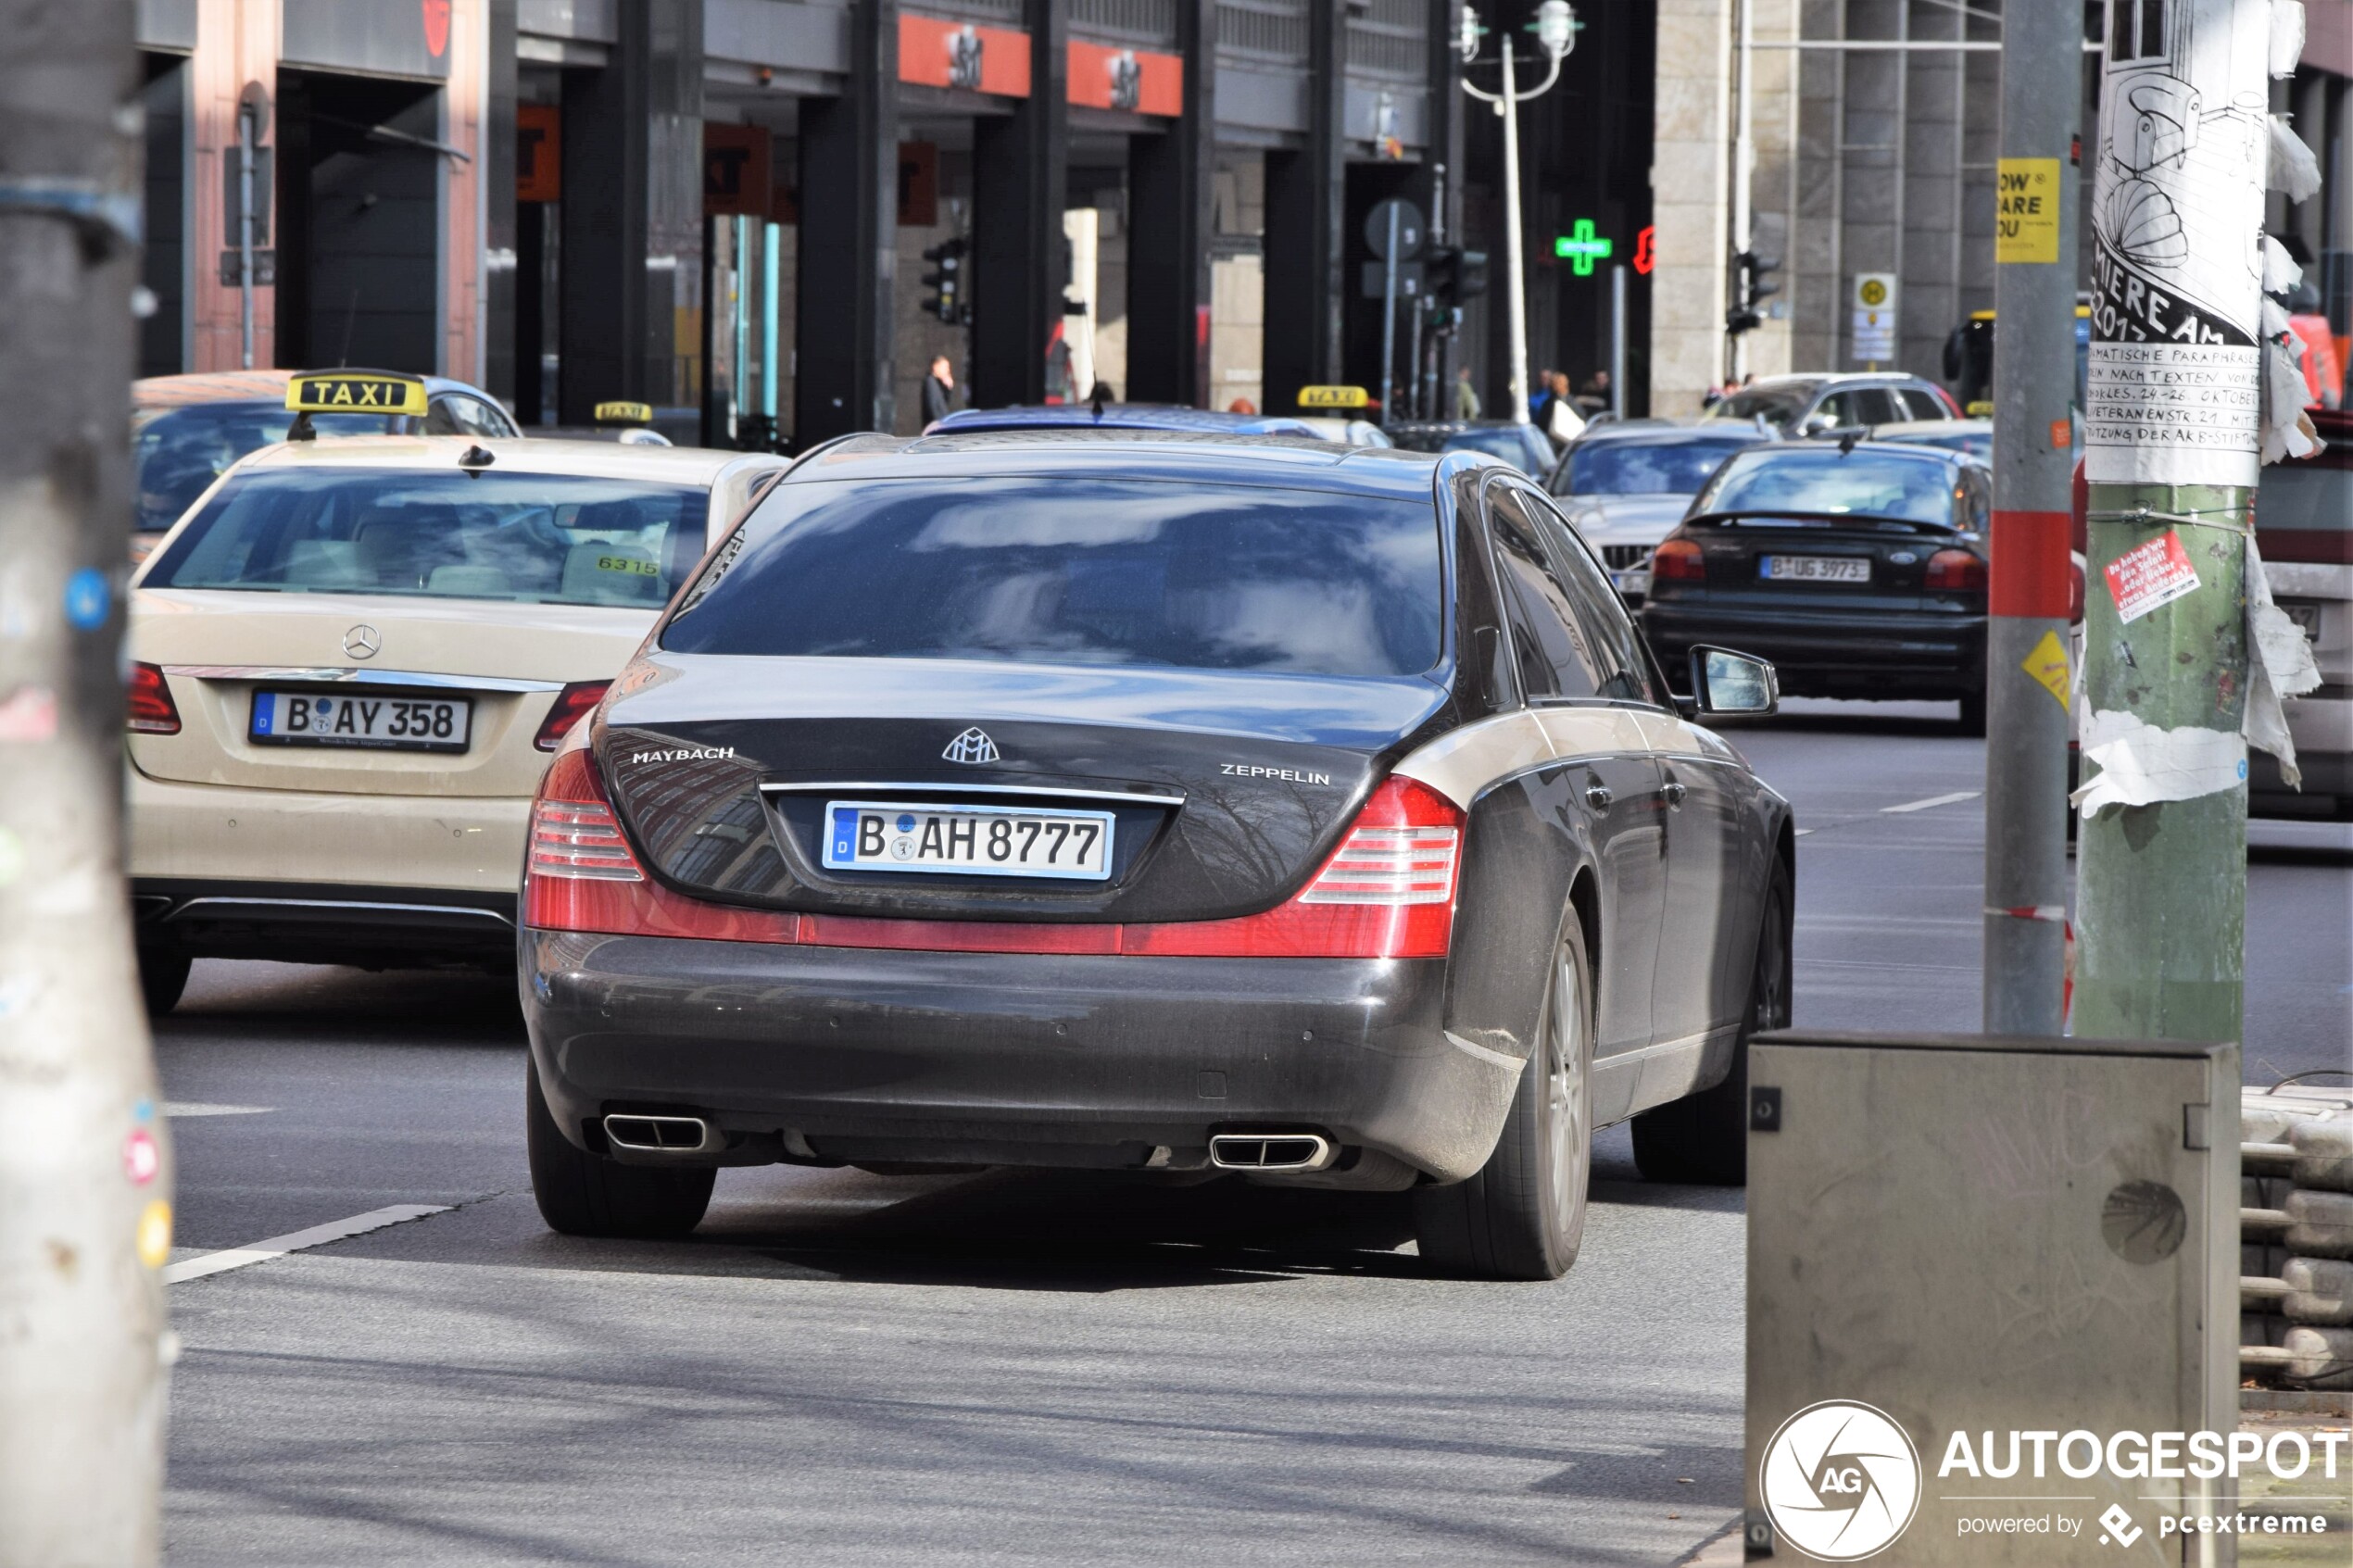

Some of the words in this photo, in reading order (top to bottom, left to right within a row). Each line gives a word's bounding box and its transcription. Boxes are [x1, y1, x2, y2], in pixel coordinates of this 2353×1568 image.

[1999, 196, 2042, 214] ARE
[2094, 241, 2170, 334] MIERE
[2171, 315, 2223, 345] AM
[2111, 370, 2145, 383] NACH
[2150, 370, 2219, 384] TEXTEN
[314, 382, 393, 406] TAXI
[2137, 428, 2171, 441] DER
[598, 558, 658, 574] 6315
[1771, 558, 1782, 575] B
[1793, 558, 1816, 576] UG
[258, 718, 268, 728] D
[287, 697, 310, 732] B
[334, 699, 382, 734] AY
[387, 702, 454, 739] 358
[632, 746, 735, 764] MAYBACH
[1220, 763, 1329, 785] ZEPPELIN
[837, 841, 848, 854] D
[858, 815, 886, 857] B
[918, 817, 976, 860] AH
[987, 819, 1100, 865] 8777
